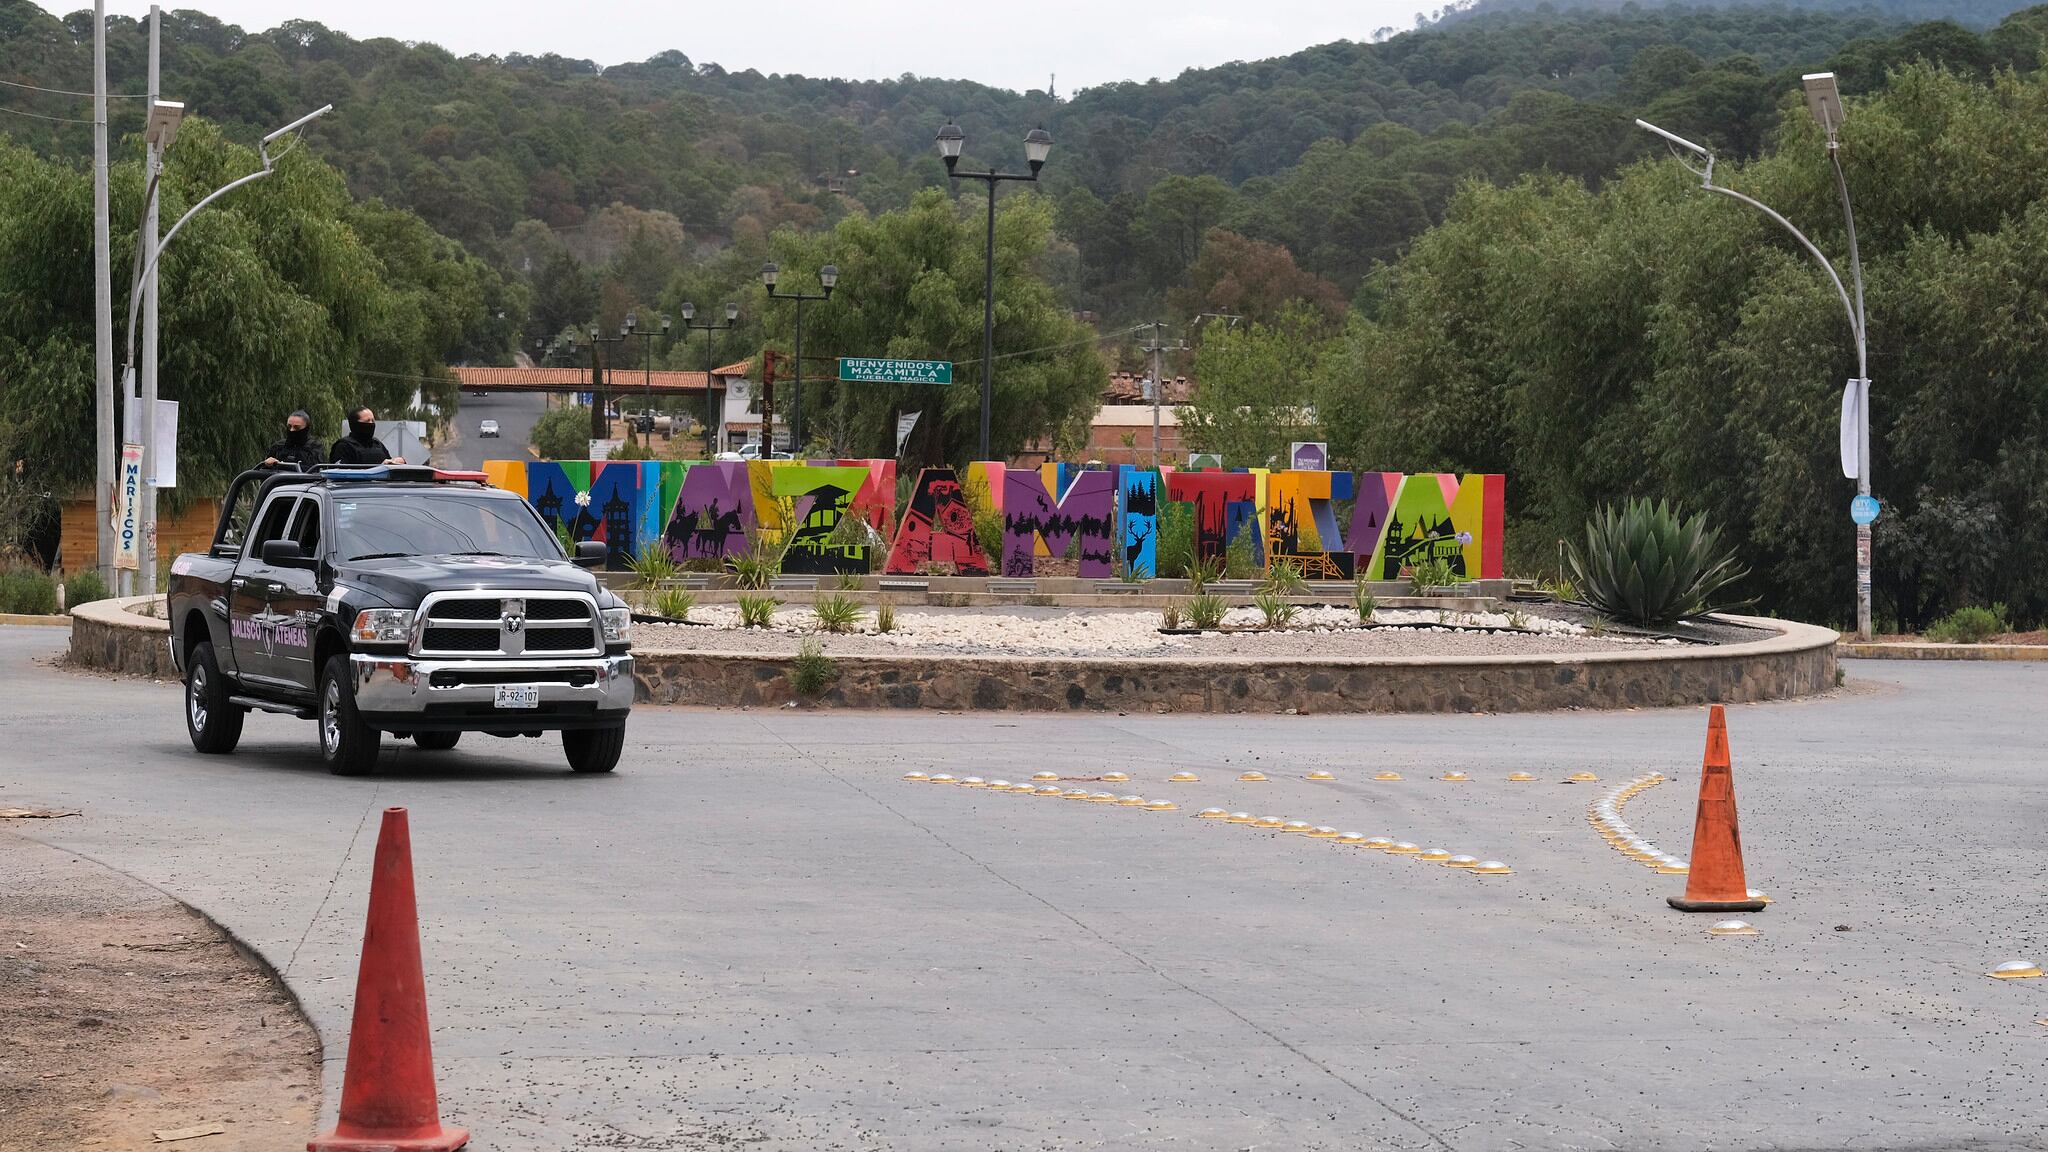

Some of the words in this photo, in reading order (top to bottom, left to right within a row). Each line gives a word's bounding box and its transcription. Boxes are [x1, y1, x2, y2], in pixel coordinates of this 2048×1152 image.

[847, 360, 932, 370] BIENVENIDOS
[851, 368, 938, 377] MAZAMITLA
[122, 464, 138, 551] MARISCOS
[231, 619, 261, 641] JALISCO
[275, 625, 308, 648] ATENEAS
[497, 691, 538, 702] JR-92-107
